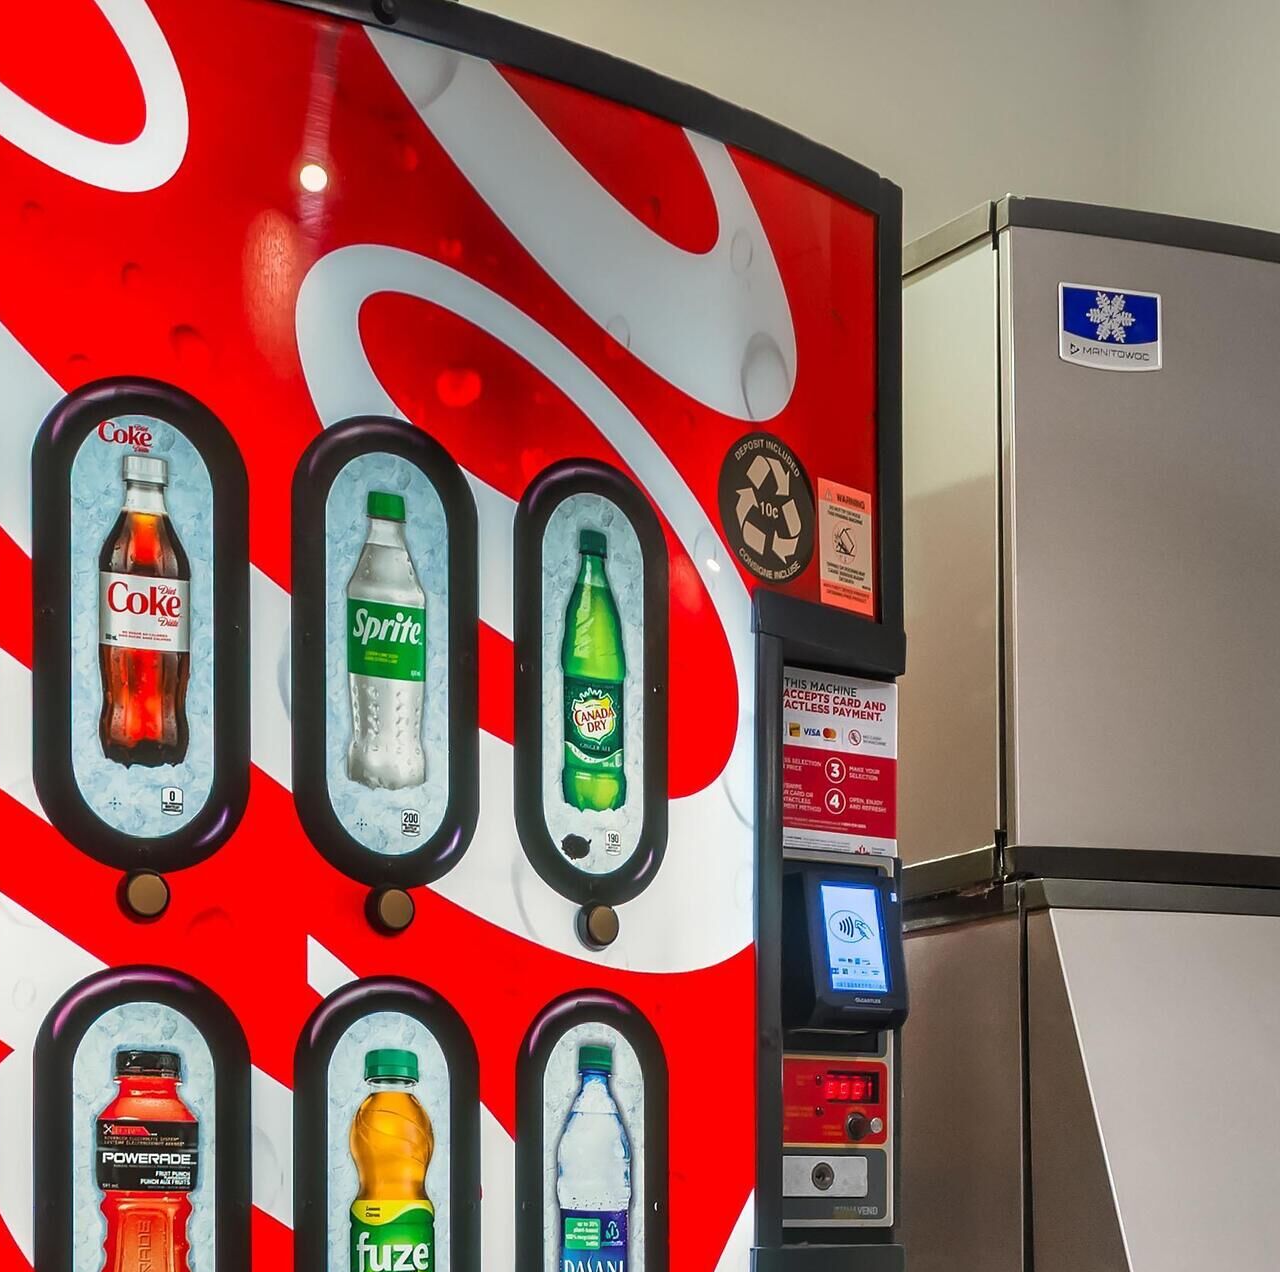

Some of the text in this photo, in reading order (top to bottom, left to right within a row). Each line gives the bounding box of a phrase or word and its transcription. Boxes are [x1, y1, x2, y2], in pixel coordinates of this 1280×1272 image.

[1082, 346, 1150, 361] MANITOWOC
[97, 420, 153, 447] Coke
[735, 438, 800, 478] DEPOSIT INCLUDED
[738, 547, 772, 579] CONSIGNE
[773, 560, 801, 580] INCLUSE
[158, 585, 177, 596] Diet
[108, 581, 182, 618] Coke
[353, 608, 422, 645] Sprite
[784, 677, 858, 697] THIS MACHINE
[783, 688, 886, 712] ACCEPTS CARD AND
[575, 707, 614, 727] CANADA
[832, 707, 883, 722] PAYMENT.
[587, 719, 607, 733] DRY
[804, 727, 821, 737] VISA
[831, 763, 840, 778] 3
[849, 772, 879, 782] SELECTION
[865, 767, 880, 775] YOUR
[169, 790, 176, 801] 0
[830, 789, 840, 809] 4
[403, 812, 419, 824] 200
[607, 833, 620, 843] 190
[102, 1151, 192, 1165] POWERADE
[356, 1232, 429, 1272] fuze
